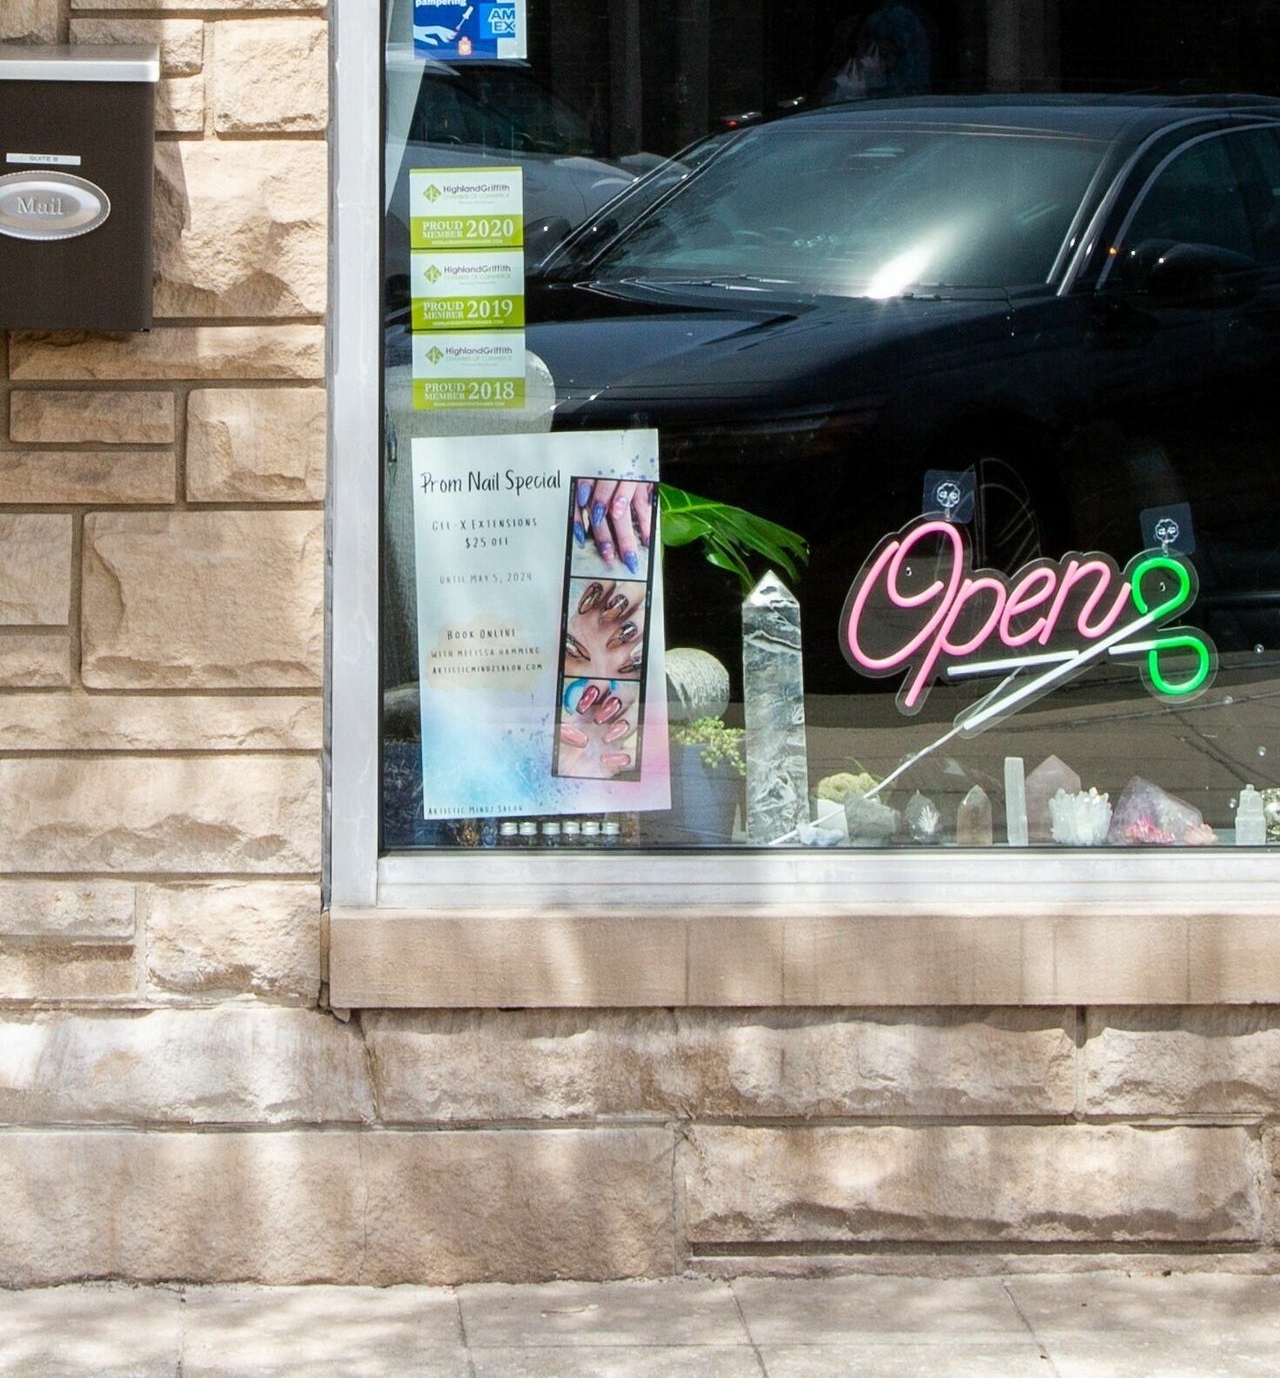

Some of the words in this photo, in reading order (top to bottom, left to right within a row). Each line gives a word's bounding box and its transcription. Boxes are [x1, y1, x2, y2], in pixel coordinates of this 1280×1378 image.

[443, 183, 510, 194] HighlandGriffith
[17, 196, 63, 216] Mail
[423, 221, 463, 230] PROUD
[466, 219, 514, 238] 2020
[423, 230, 463, 238] MEMBER
[444, 264, 511, 275] HighlandGriffith
[423, 301, 464, 311] PROUD
[467, 299, 513, 318] 2019
[423, 311, 463, 320] MEMBER
[446, 346, 512, 356] HighlandGriffith
[425, 382, 465, 392] PROUD
[468, 381, 514, 400] 2018
[425, 392, 465, 400] MEMBER
[420, 472, 462, 494] Prom
[468, 471, 499, 492] Nail
[505, 469, 561, 496] Special
[465, 537, 487, 549] $25
[848, 520, 1132, 707] Open
